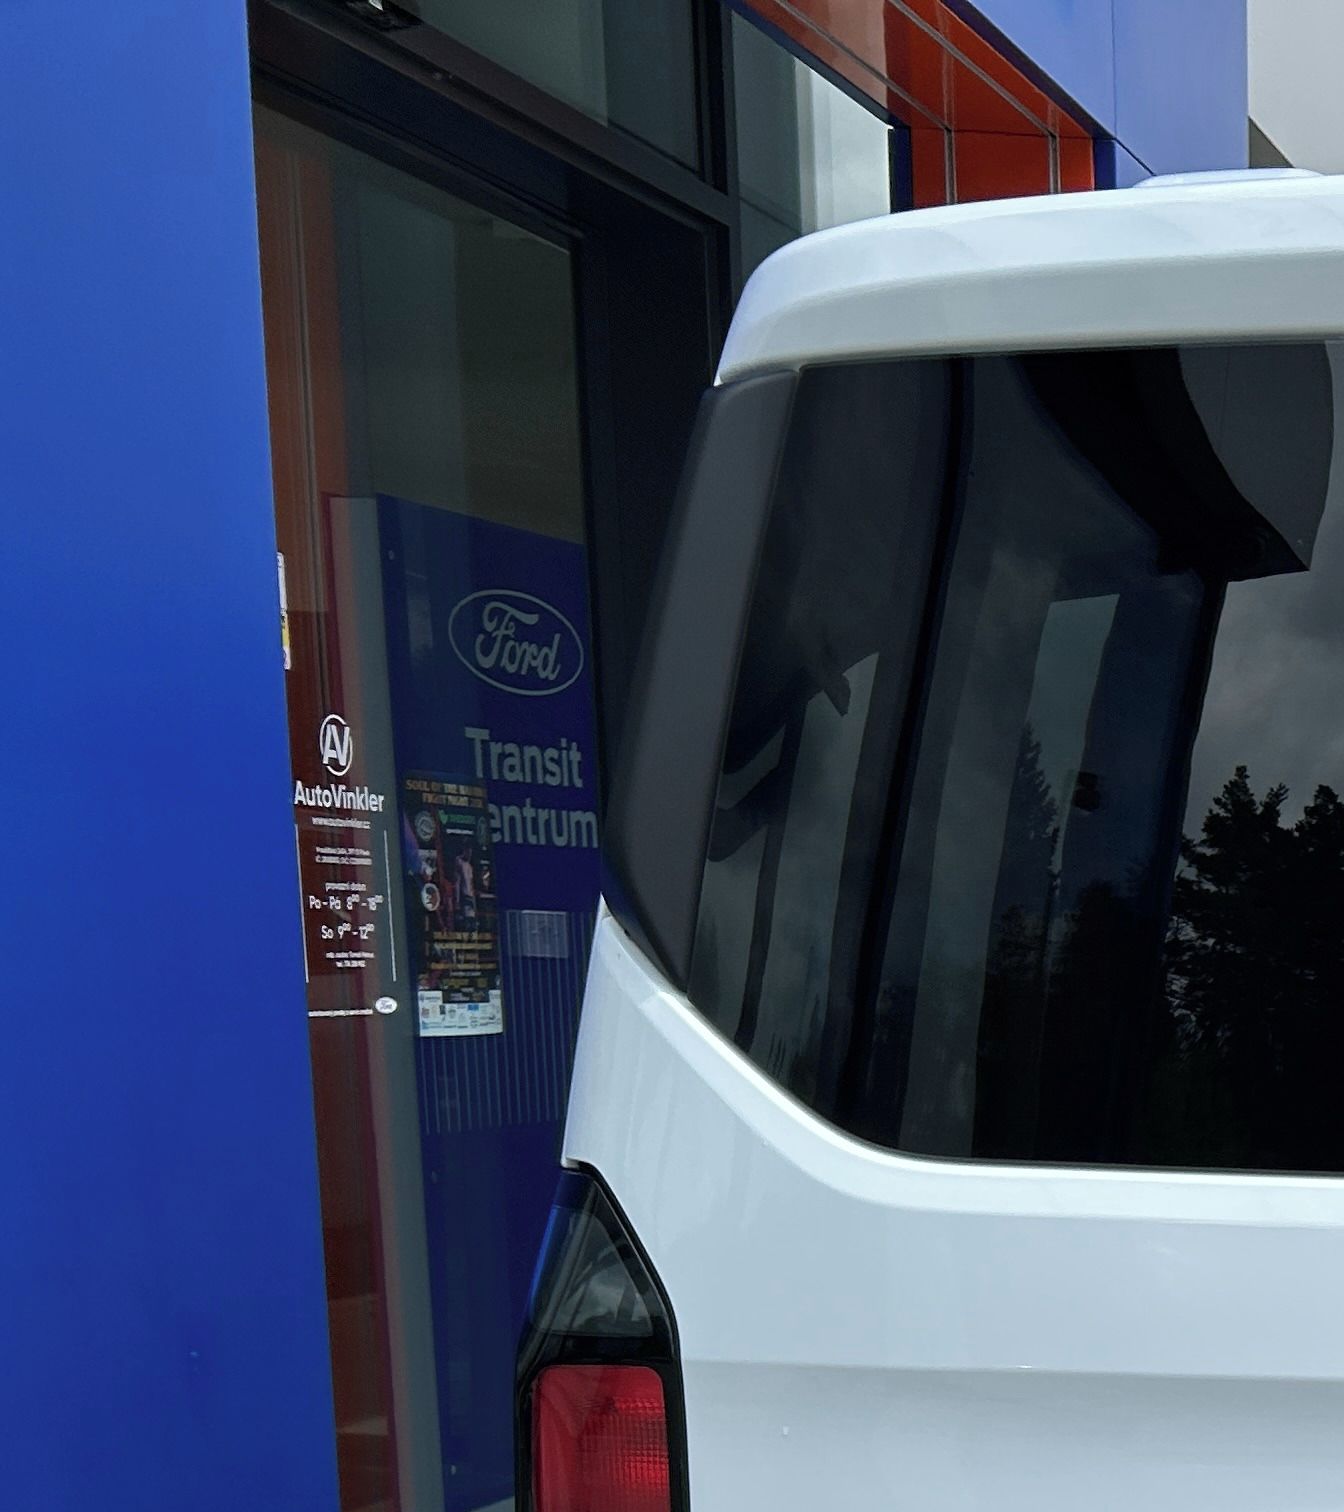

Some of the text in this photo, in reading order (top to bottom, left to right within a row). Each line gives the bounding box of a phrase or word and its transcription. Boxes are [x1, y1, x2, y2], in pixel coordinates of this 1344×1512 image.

[475, 601, 561, 681] Ford
[465, 727, 583, 788] Transit
[294, 780, 385, 812] AutoVinkler
[488, 798, 599, 848] entrum
